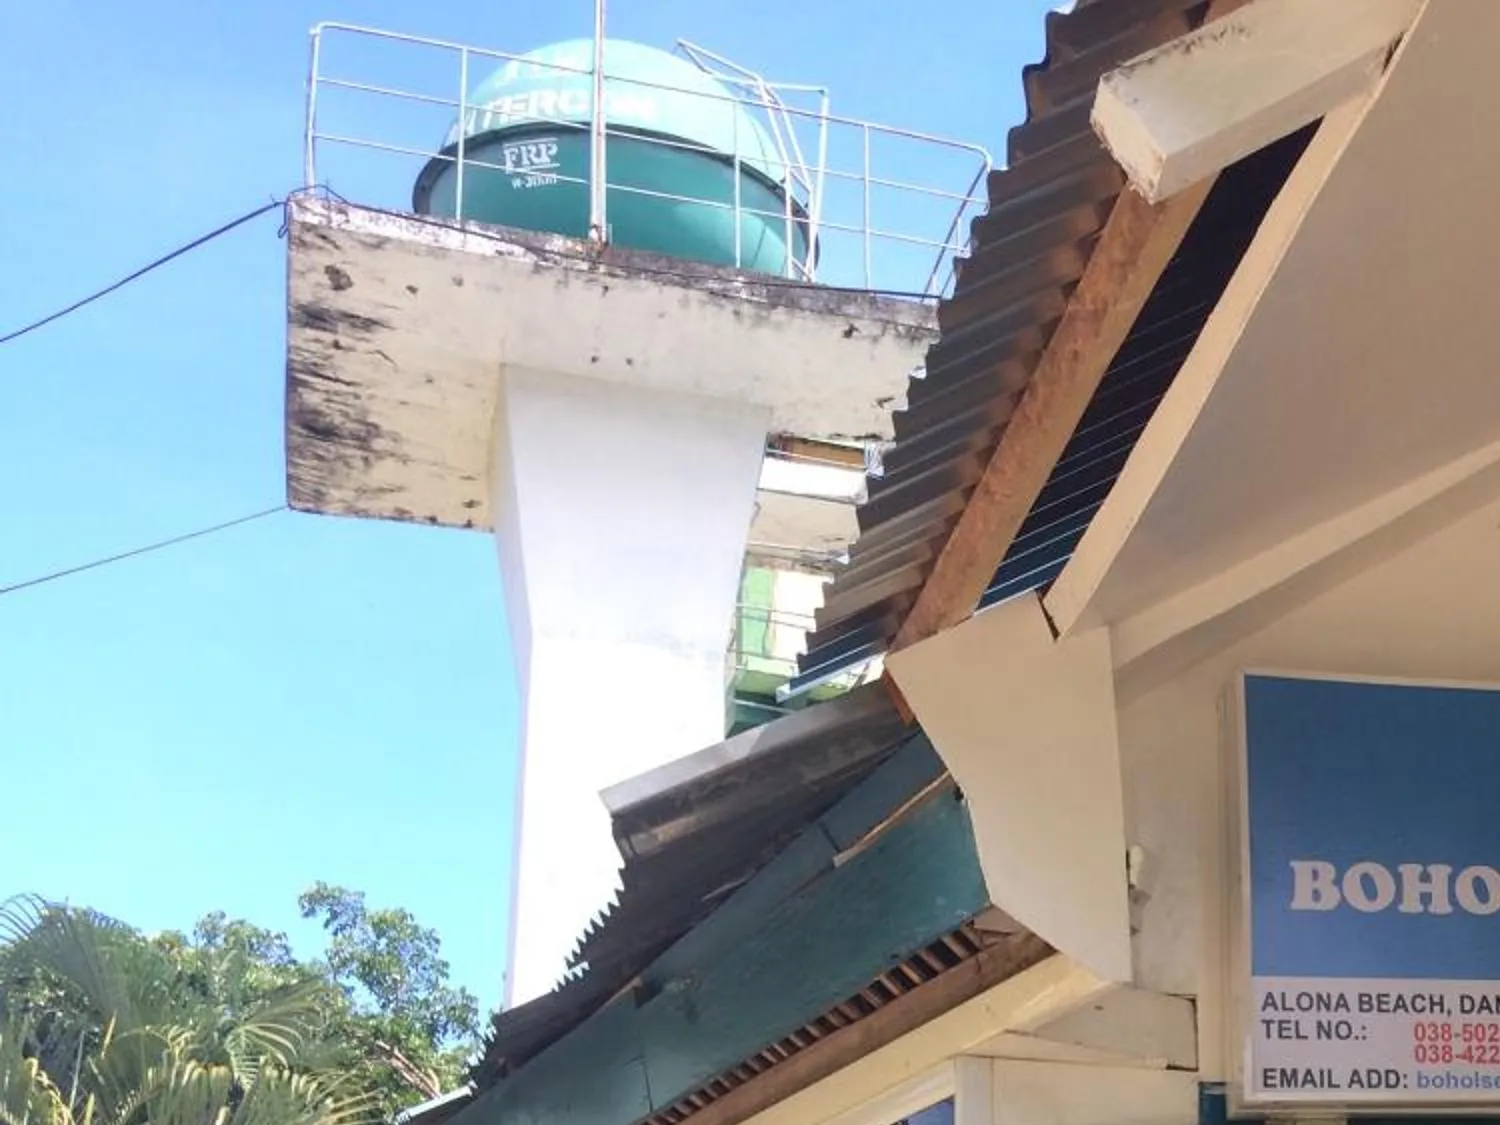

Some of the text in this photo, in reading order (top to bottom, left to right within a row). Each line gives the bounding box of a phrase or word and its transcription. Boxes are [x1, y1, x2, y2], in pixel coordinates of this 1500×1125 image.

[504, 143, 559, 173] FRP
[1260, 991, 1351, 1014] ALONA
[1357, 992, 1453, 1018] BEACH,
[1261, 1019, 1309, 1041] TEL
[1315, 1019, 1368, 1042] NO.:
[1262, 1067, 1341, 1090] EMAIL
[1347, 1068, 1409, 1090] ADD:
